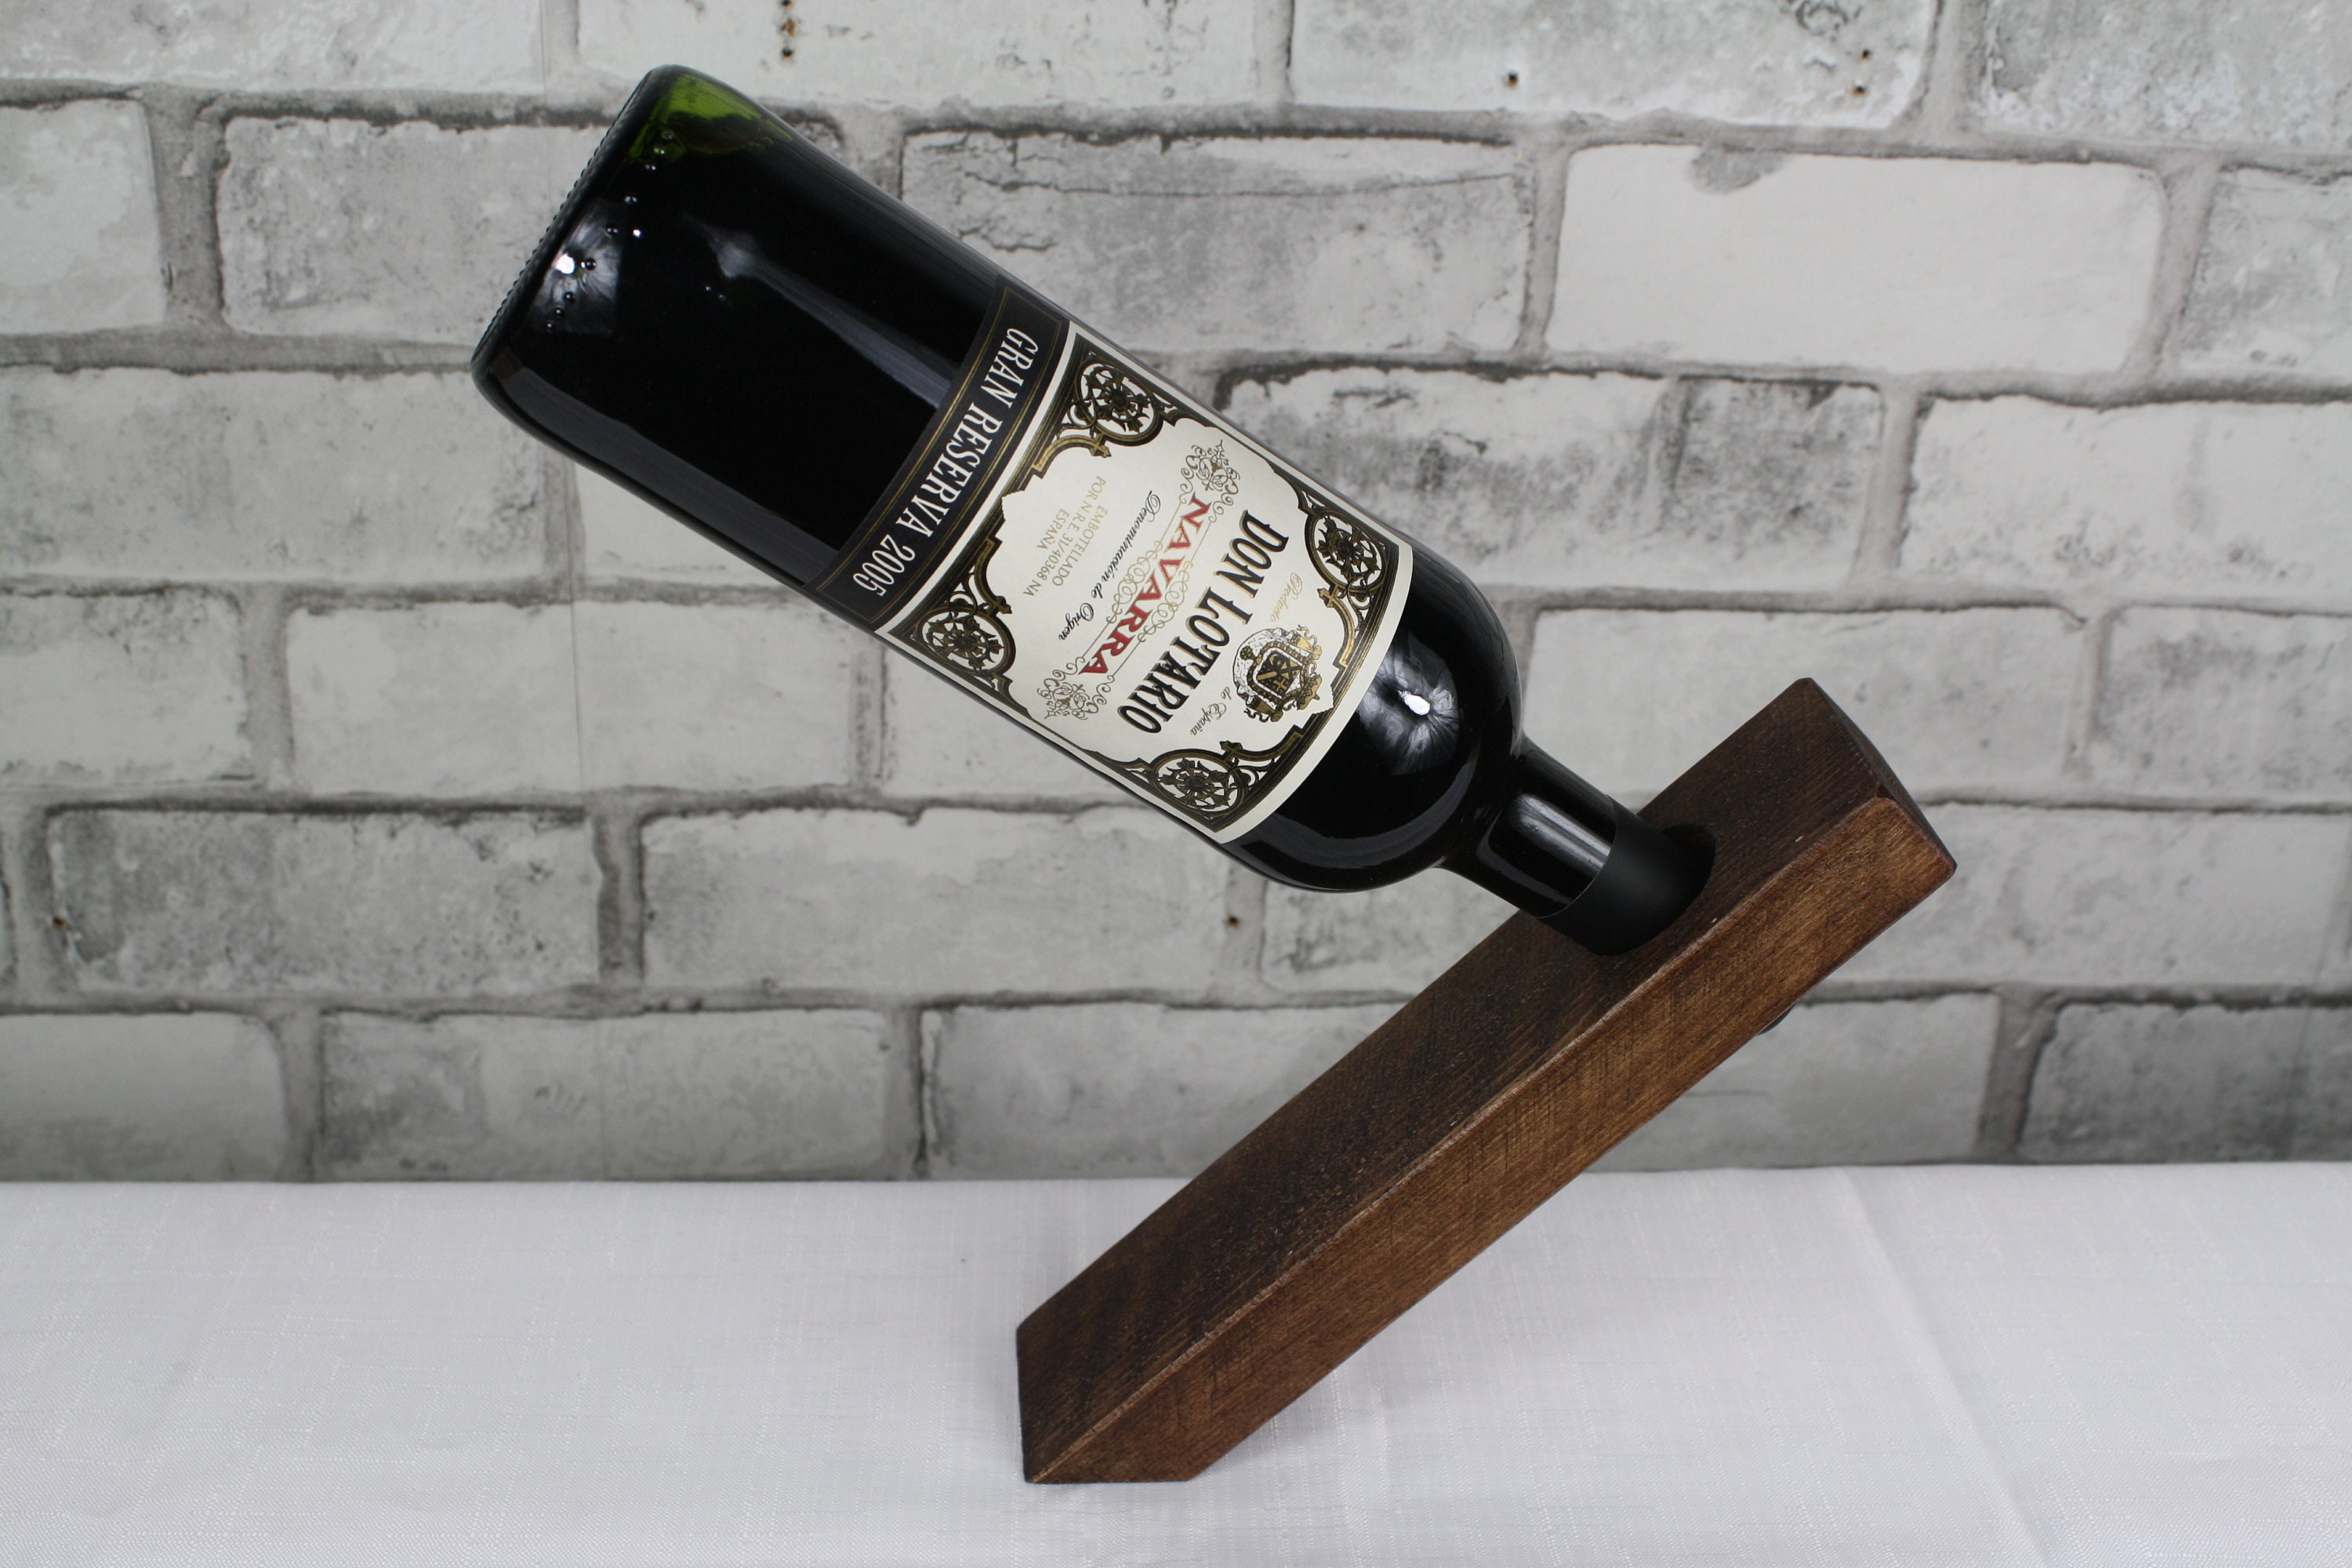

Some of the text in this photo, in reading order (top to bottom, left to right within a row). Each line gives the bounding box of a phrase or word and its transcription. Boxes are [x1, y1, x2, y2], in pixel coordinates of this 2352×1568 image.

[853, 328, 1039, 597] GRAN RESERVA 2005
[1086, 476, 1107, 500] POR
[1036, 508, 1070, 550] ESPAÑA
[1052, 505, 1109, 586] EMBOTELLADO
[1023, 579, 1042, 597] NA
[1058, 490, 1161, 641] Denominación de Origen
[1078, 491, 1212, 675] NAVARRA
[1117, 510, 1290, 734] DON LOTARIO
[1190, 702, 1228, 735] España
[1221, 686, 1232, 700] de
